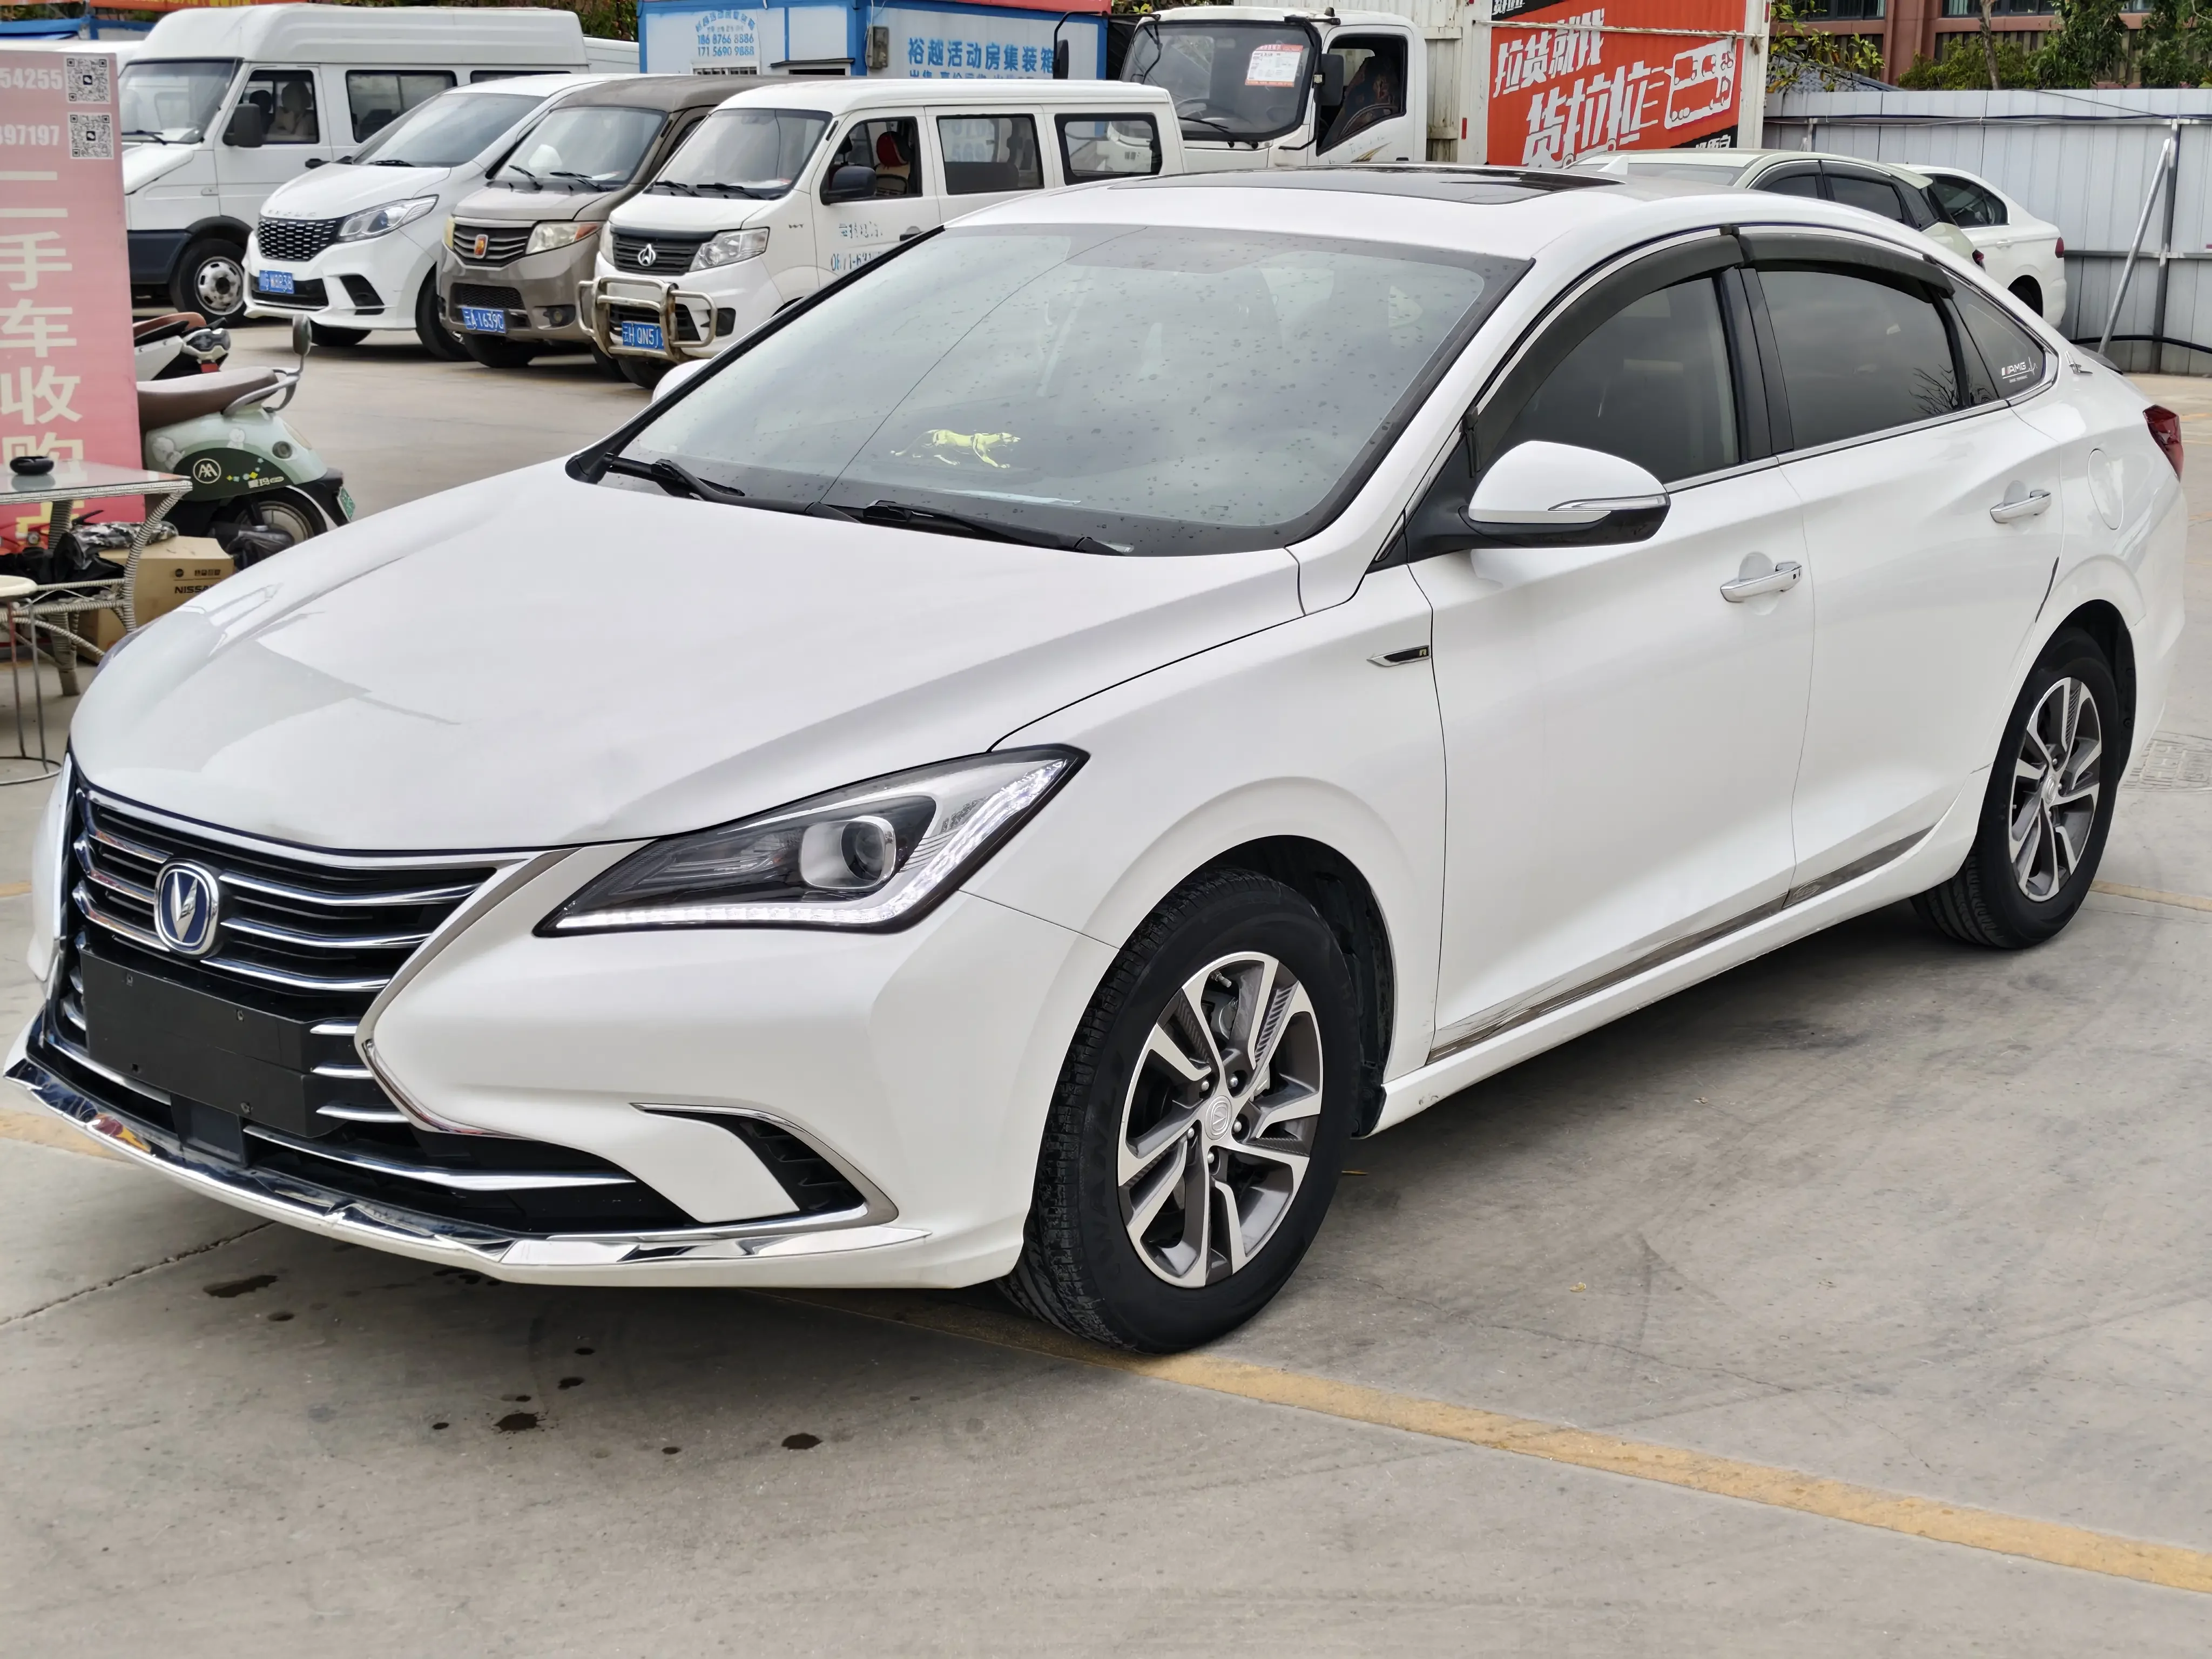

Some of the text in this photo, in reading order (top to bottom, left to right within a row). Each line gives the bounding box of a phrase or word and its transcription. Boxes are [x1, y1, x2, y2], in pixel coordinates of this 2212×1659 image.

[908, 37, 1054, 73] 裕越活动房集装箱
[1522, 60, 1651, 167] 货拉拉
[0, 124, 60, 146] 97197
